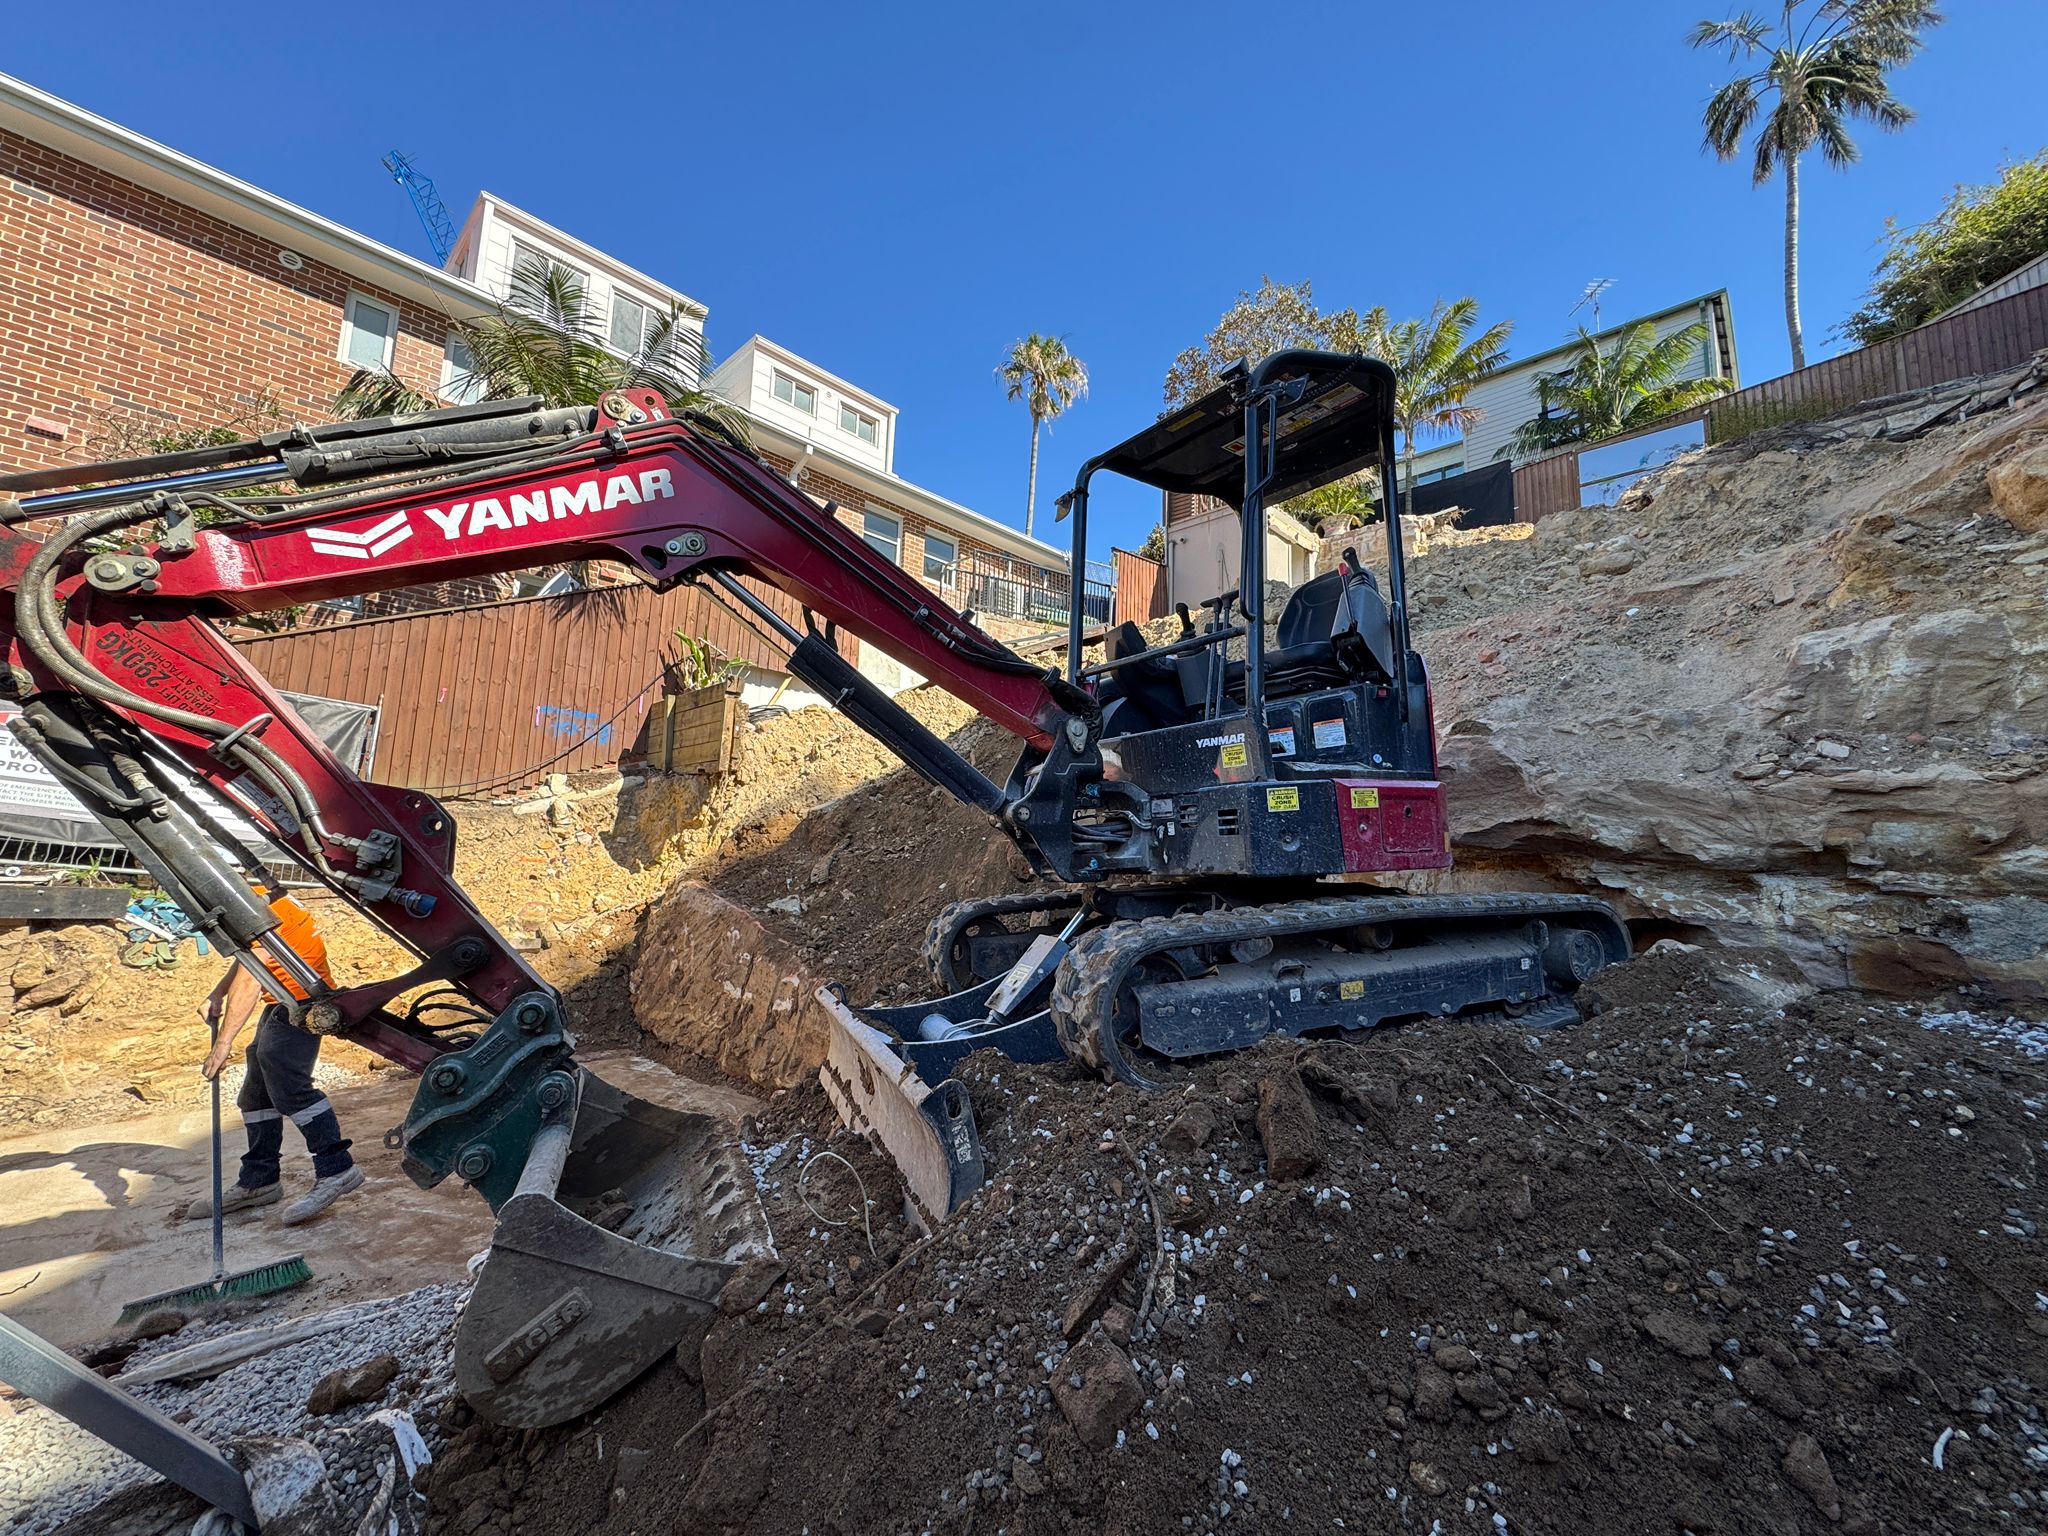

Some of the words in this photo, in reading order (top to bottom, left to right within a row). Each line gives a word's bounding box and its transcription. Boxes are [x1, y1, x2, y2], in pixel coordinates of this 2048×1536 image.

[423, 468, 675, 540] YANMAR
[96, 630, 172, 688] 290KG
[122, 630, 196, 687] ATTACHMENTS
[171, 683, 216, 717] CAPACITY
[195, 684, 220, 707] LESS
[1196, 733, 1245, 748] YANMAR
[10, 784, 57, 794] EMERGENCY
[19, 797, 53, 805] NUMBER
